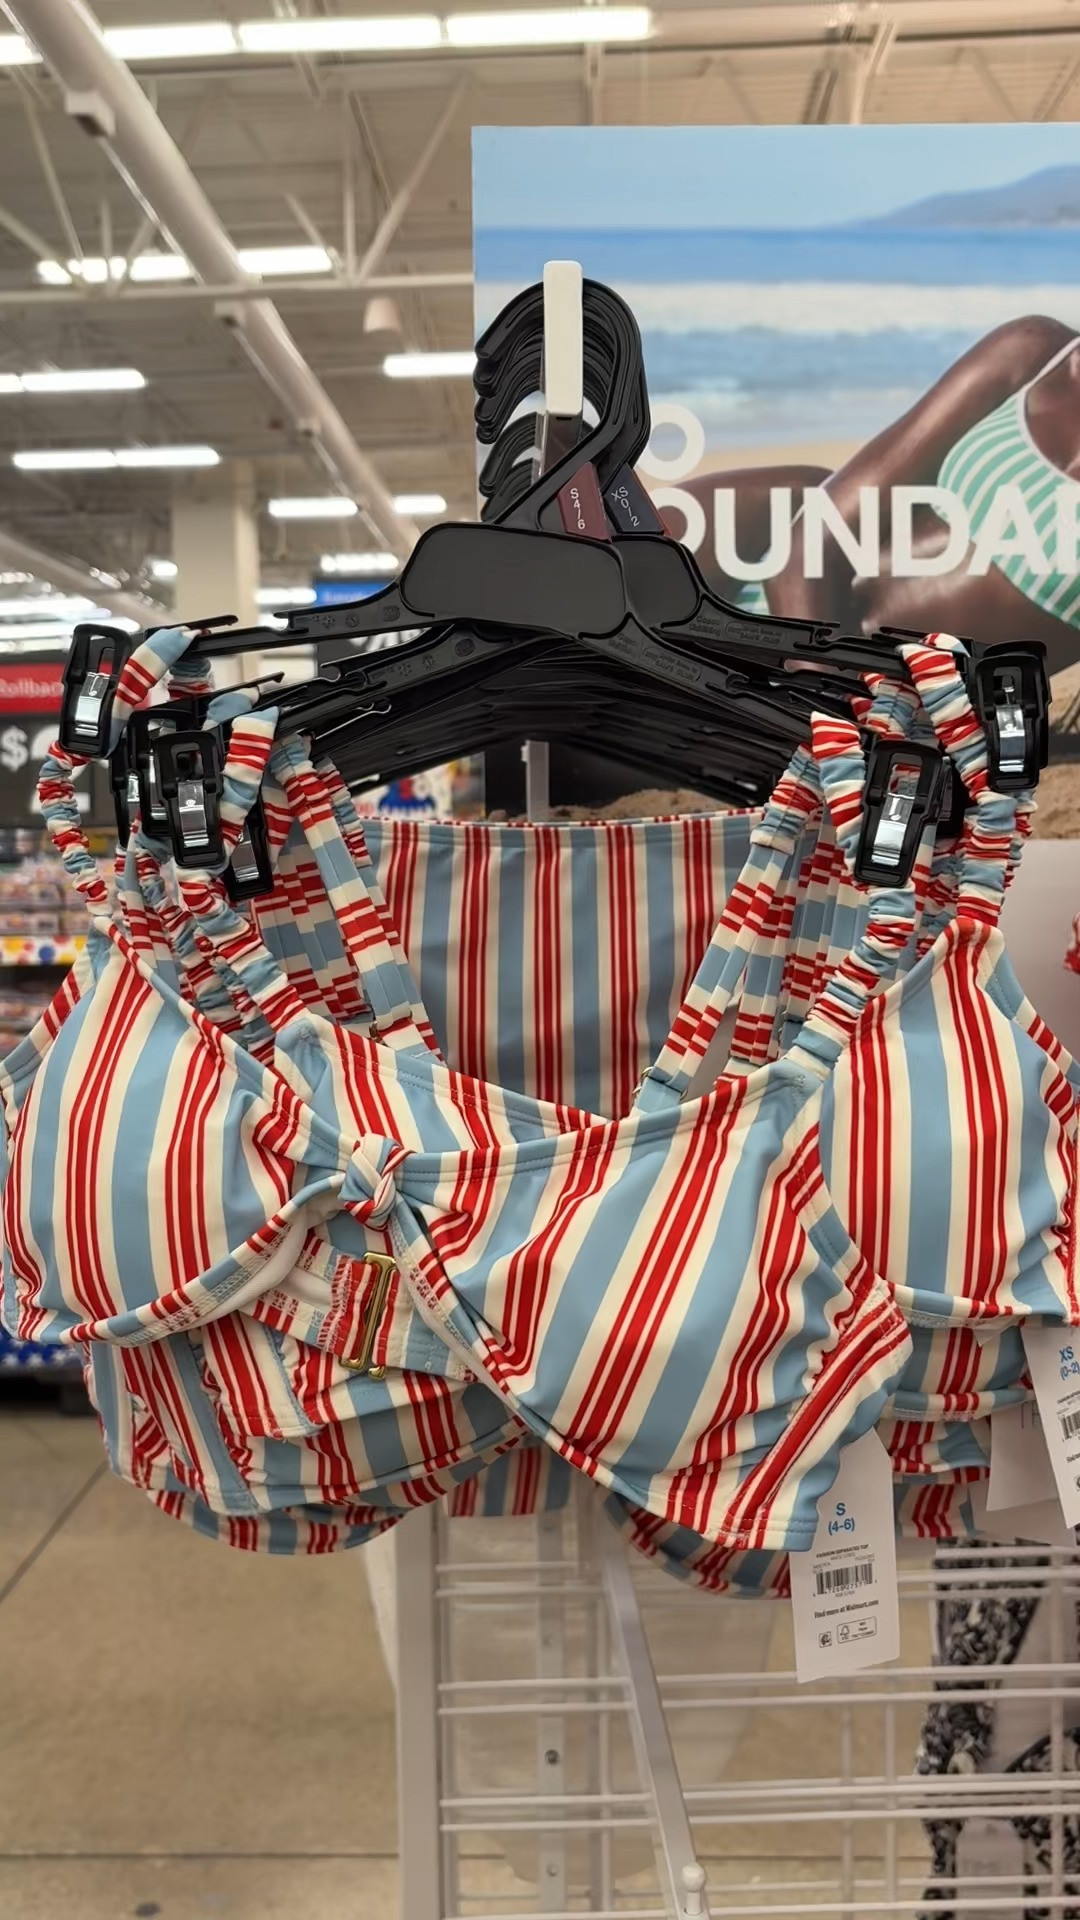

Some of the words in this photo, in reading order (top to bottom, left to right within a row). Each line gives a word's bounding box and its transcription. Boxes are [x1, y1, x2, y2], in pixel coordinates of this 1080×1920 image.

[635, 404, 706, 481] O
[570, 487, 579, 499] S
[611, 486, 628, 502] XS
[1059, 1345, 1074, 1363] XS
[836, 1502, 846, 1516] S
[828, 1517, 855, 1536] (4-6)
[814, 1609, 826, 1618] Find
[826, 1608, 839, 1616] more
[846, 1599, 879, 1612] Walmart.com
